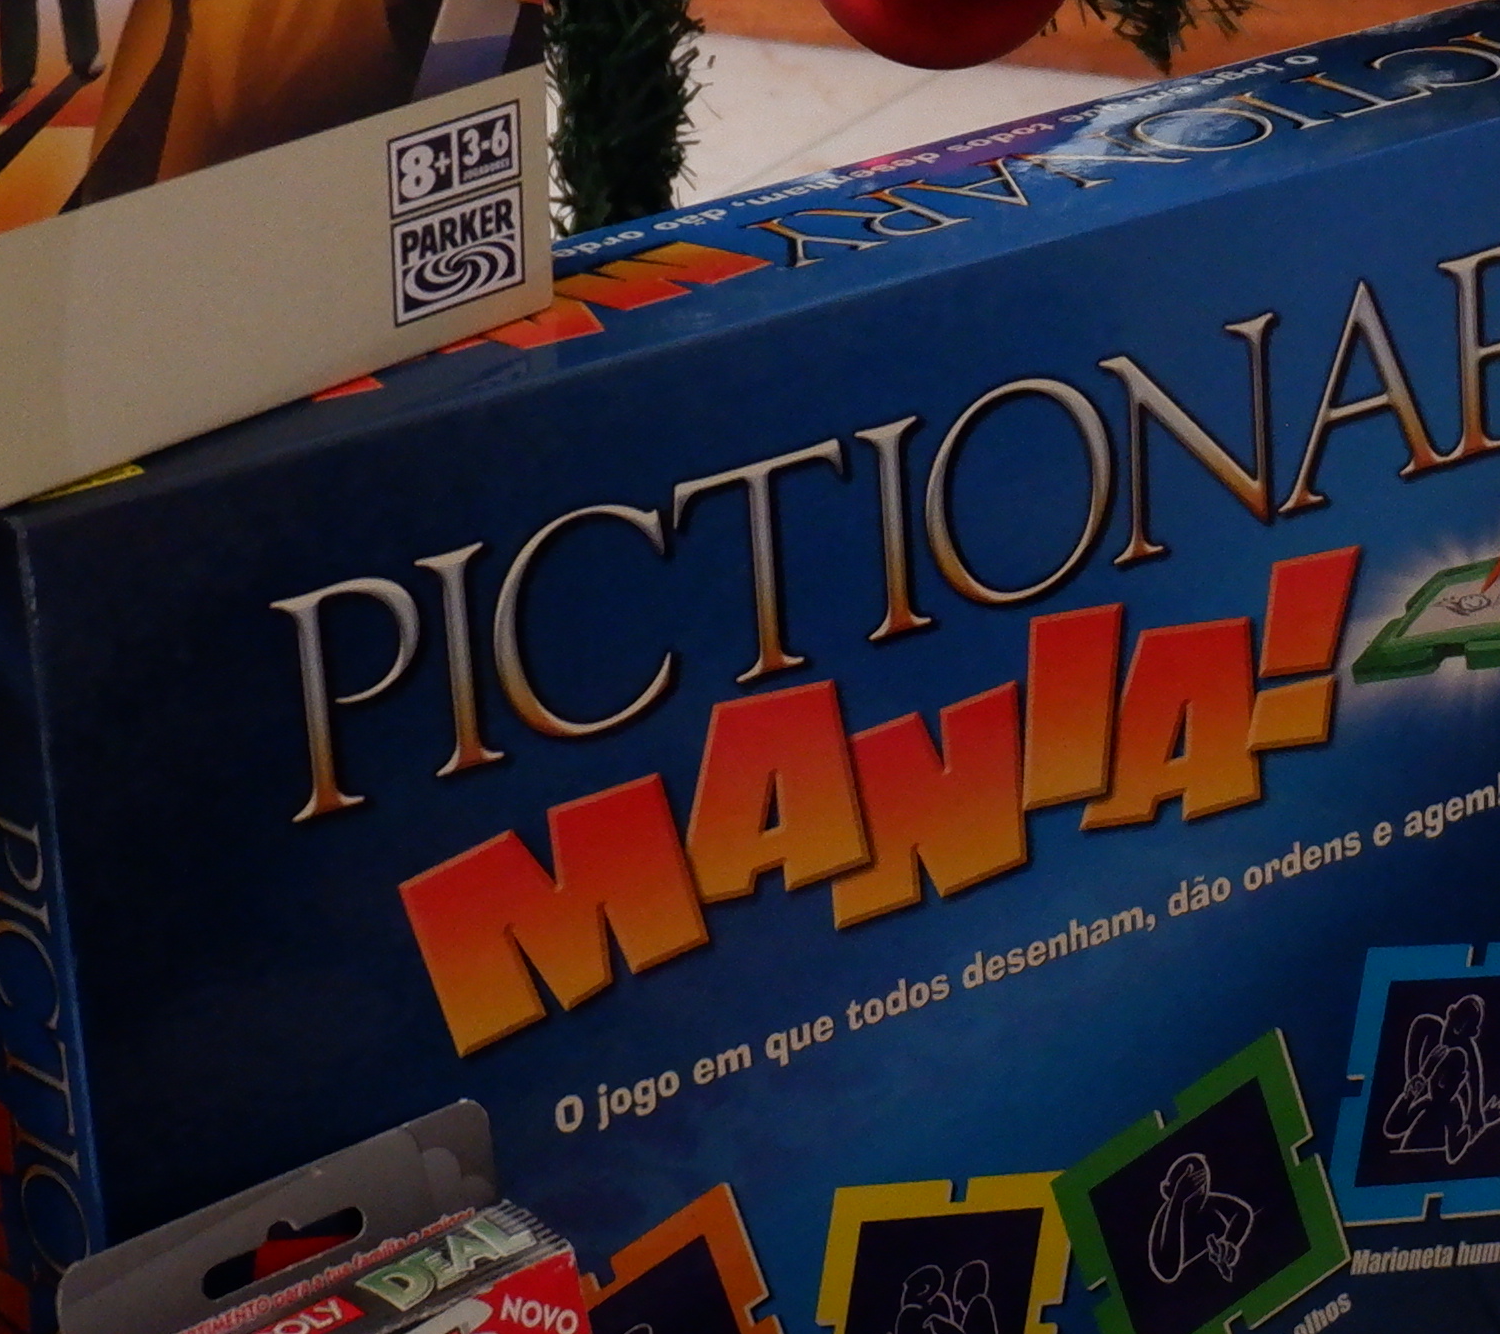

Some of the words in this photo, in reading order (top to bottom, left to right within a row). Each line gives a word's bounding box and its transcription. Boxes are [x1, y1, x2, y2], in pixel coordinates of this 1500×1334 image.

[400, 143, 451, 200] 8+
[462, 118, 511, 167] 3-6
[400, 198, 516, 267] PARKER
[552, 228, 646, 259] orde
[398, 544, 1363, 1058] MANIA!
[554, 1093, 586, 1134] O
[597, 1069, 681, 1132] jogo
[692, 1042, 753, 1086] em
[764, 1013, 836, 1068] que
[845, 971, 951, 1032] todos
[961, 906, 1157, 991] desenham,
[1167, 873, 1231, 918] dão
[1242, 829, 1362, 894] ordens
[1372, 817, 1394, 848] e
[355, 1216, 537, 1312] DEAL
[1349, 1240, 1456, 1277] Marioneta
